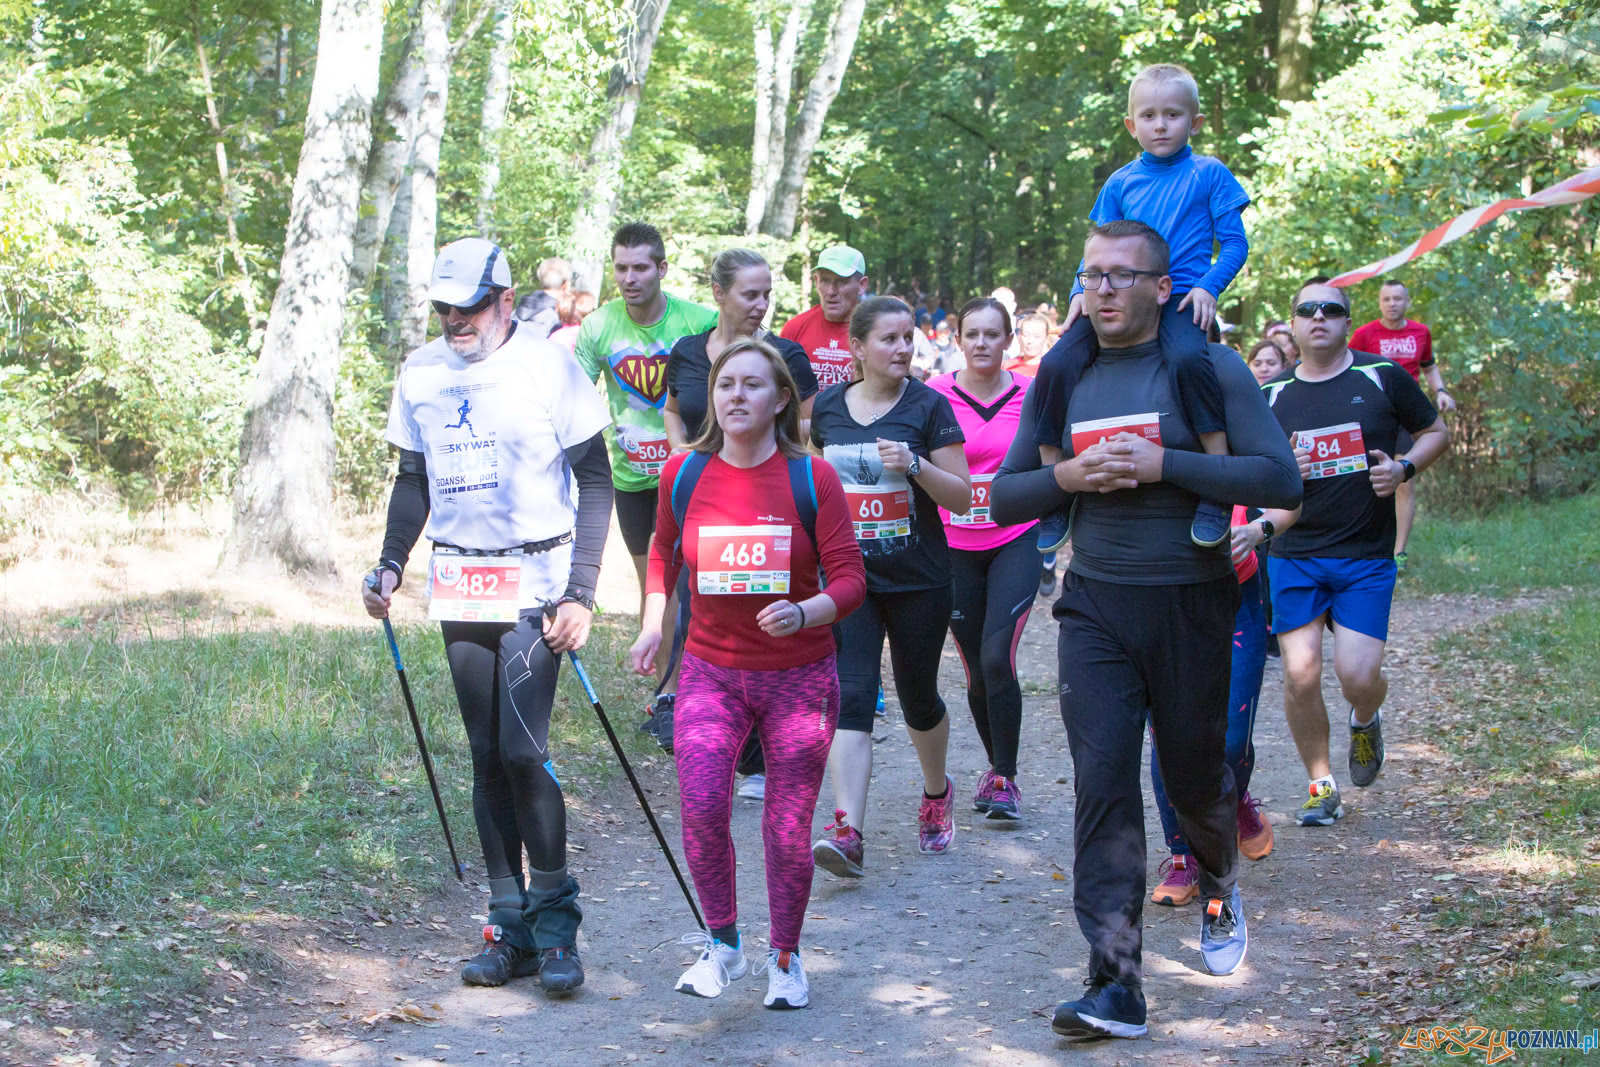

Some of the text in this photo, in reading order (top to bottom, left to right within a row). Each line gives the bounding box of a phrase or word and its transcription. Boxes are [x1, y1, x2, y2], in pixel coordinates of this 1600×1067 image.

[448, 440, 496, 454] SKYWAY
[639, 445, 667, 460] 506
[1317, 439, 1341, 458] 84
[859, 499, 884, 518] 60
[720, 543, 767, 566] 468
[455, 573, 499, 596] 482
